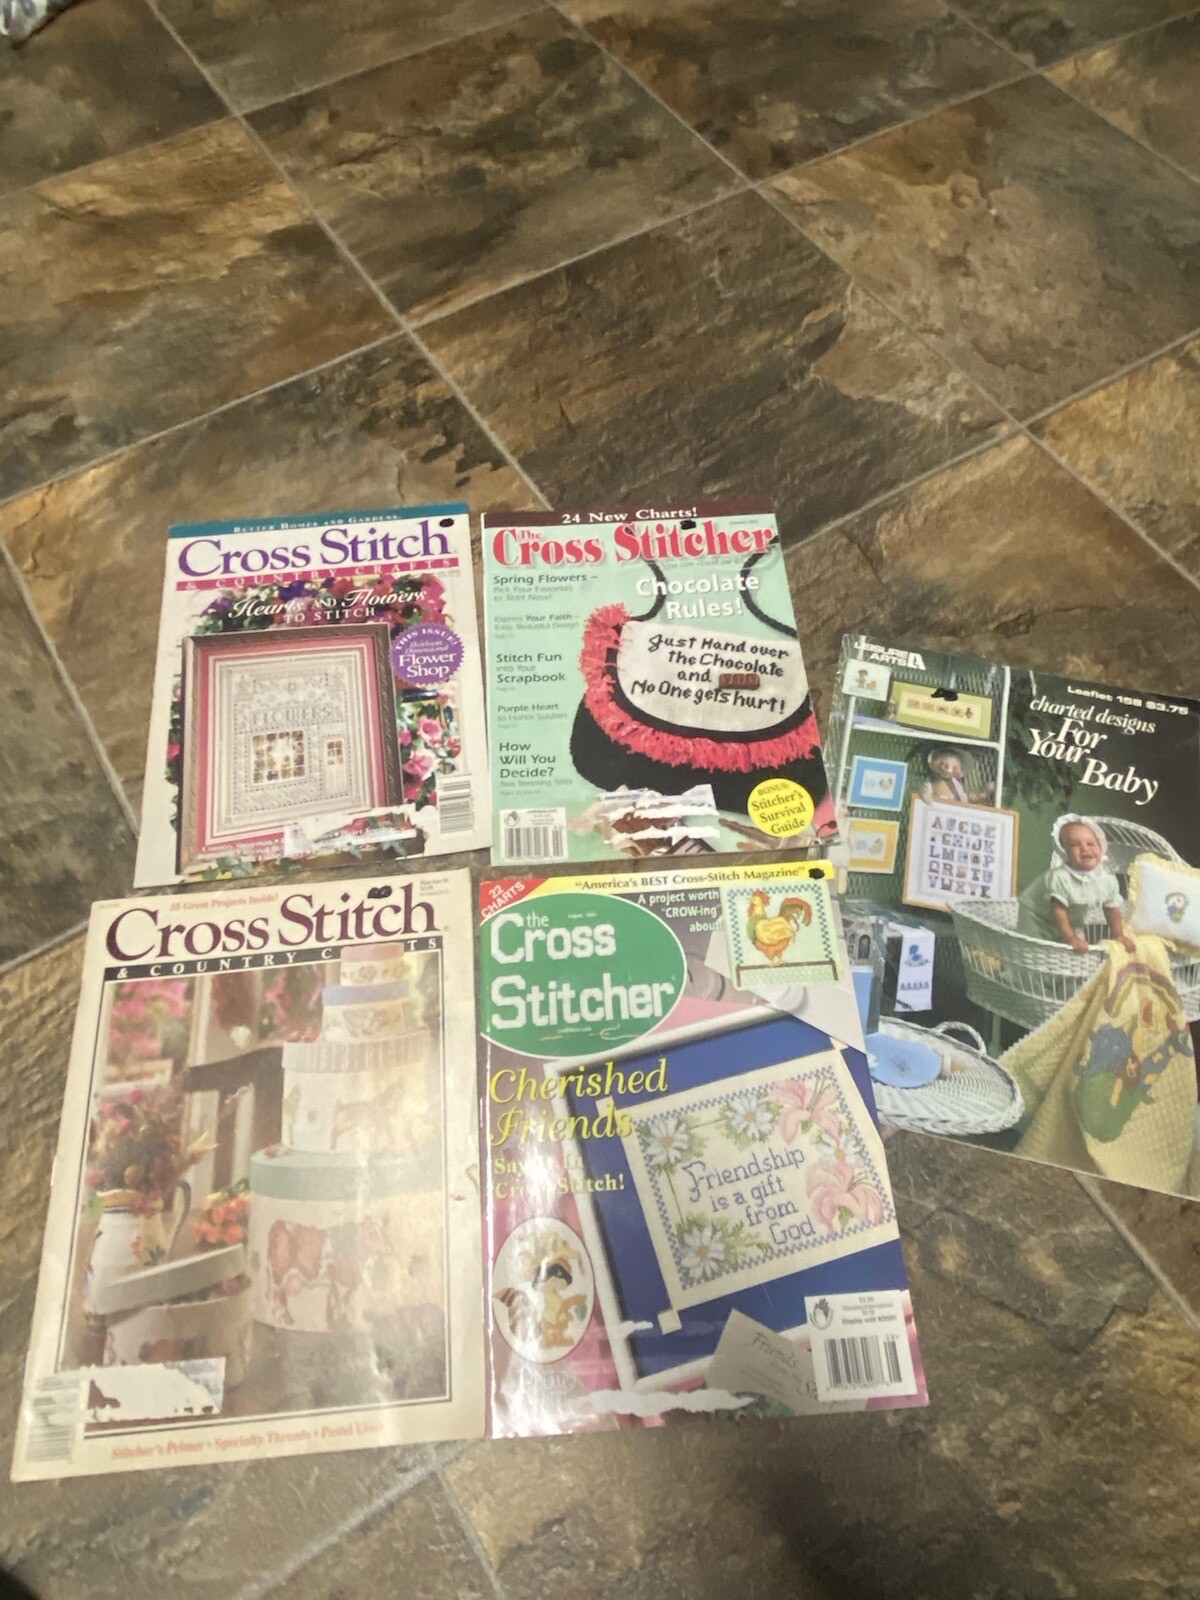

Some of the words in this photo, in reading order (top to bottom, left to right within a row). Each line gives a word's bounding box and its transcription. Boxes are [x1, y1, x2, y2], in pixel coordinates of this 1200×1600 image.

[562, 513, 581, 524] 24
[588, 512, 629, 522] New
[635, 507, 698, 520] Charts!
[492, 528, 604, 567] Cross
[614, 520, 774, 563] Stitcher
[520, 530, 543, 540] The
[178, 539, 312, 577] Cross
[320, 519, 452, 566] Stitch
[216, 569, 338, 588] COUNTRY
[354, 559, 450, 575] CRAFTS
[493, 575, 534, 586] Spring
[538, 573, 587, 584] Flowers
[636, 573, 761, 597] Chocolate
[228, 597, 304, 619] Hearts
[314, 597, 337, 608] AND
[341, 588, 427, 608] Flowers
[285, 612, 305, 623] TO
[314, 607, 376, 620] STITCH
[665, 597, 743, 620] Rules!
[525, 614, 546, 622] Your
[549, 613, 573, 621] Faith
[395, 631, 419, 650] THIS
[648, 633, 696, 653] Just
[701, 637, 747, 654] Hand
[750, 645, 790, 660] over
[399, 653, 457, 667] Flower
[496, 653, 533, 663] Stitch
[537, 652, 562, 662] Fun
[668, 650, 697, 665] the
[700, 653, 785, 678] Chocolate
[869, 653, 907, 667] ARTS
[406, 664, 450, 679] Shop
[496, 672, 566, 685] Scrapbook
[677, 668, 712, 683] and
[631, 679, 656, 695] No
[658, 680, 692, 698] One
[694, 687, 730, 705] gets
[733, 690, 786, 715] hurt!
[1067, 685, 1113, 701] Leaflet
[497, 705, 529, 714] Purple
[532, 703, 559, 711] Heart
[1029, 695, 1095, 722] charted
[1095, 709, 1157, 736] designs
[1055, 717, 1108, 749] For
[499, 742, 532, 752] How
[1028, 728, 1091, 764] Your
[500, 755, 526, 765] Will
[531, 754, 557, 765] You
[500, 767, 554, 779] Decide?
[1079, 757, 1159, 806] Baby
[751, 789, 804, 812] Stitcher's
[760, 802, 806, 824] Survival
[771, 817, 806, 835] Guide
[641, 876, 668, 887] BEST
[673, 869, 741, 885] Cross-Stitch
[481, 881, 526, 919] CHARTS
[488, 884, 504, 900] 22
[638, 894, 647, 905] A
[649, 891, 686, 908] project
[688, 889, 720, 901] worth
[105, 908, 270, 962] Cross
[278, 882, 440, 947] Stitch
[526, 911, 550, 928] the
[490, 913, 617, 965] Cross
[117, 967, 128, 979] &
[150, 949, 297, 977] COUNTRY
[321, 937, 438, 960] CTS
[490, 972, 675, 1030] Stitcher
[489, 1057, 669, 1104] Cherished
[488, 1103, 634, 1147] Friends
[682, 1147, 805, 1203] Friendship
[710, 1195, 730, 1213] is
[733, 1191, 747, 1205] a
[750, 1174, 786, 1207] gift
[745, 1200, 799, 1227] from
[768, 1214, 817, 1246] God
